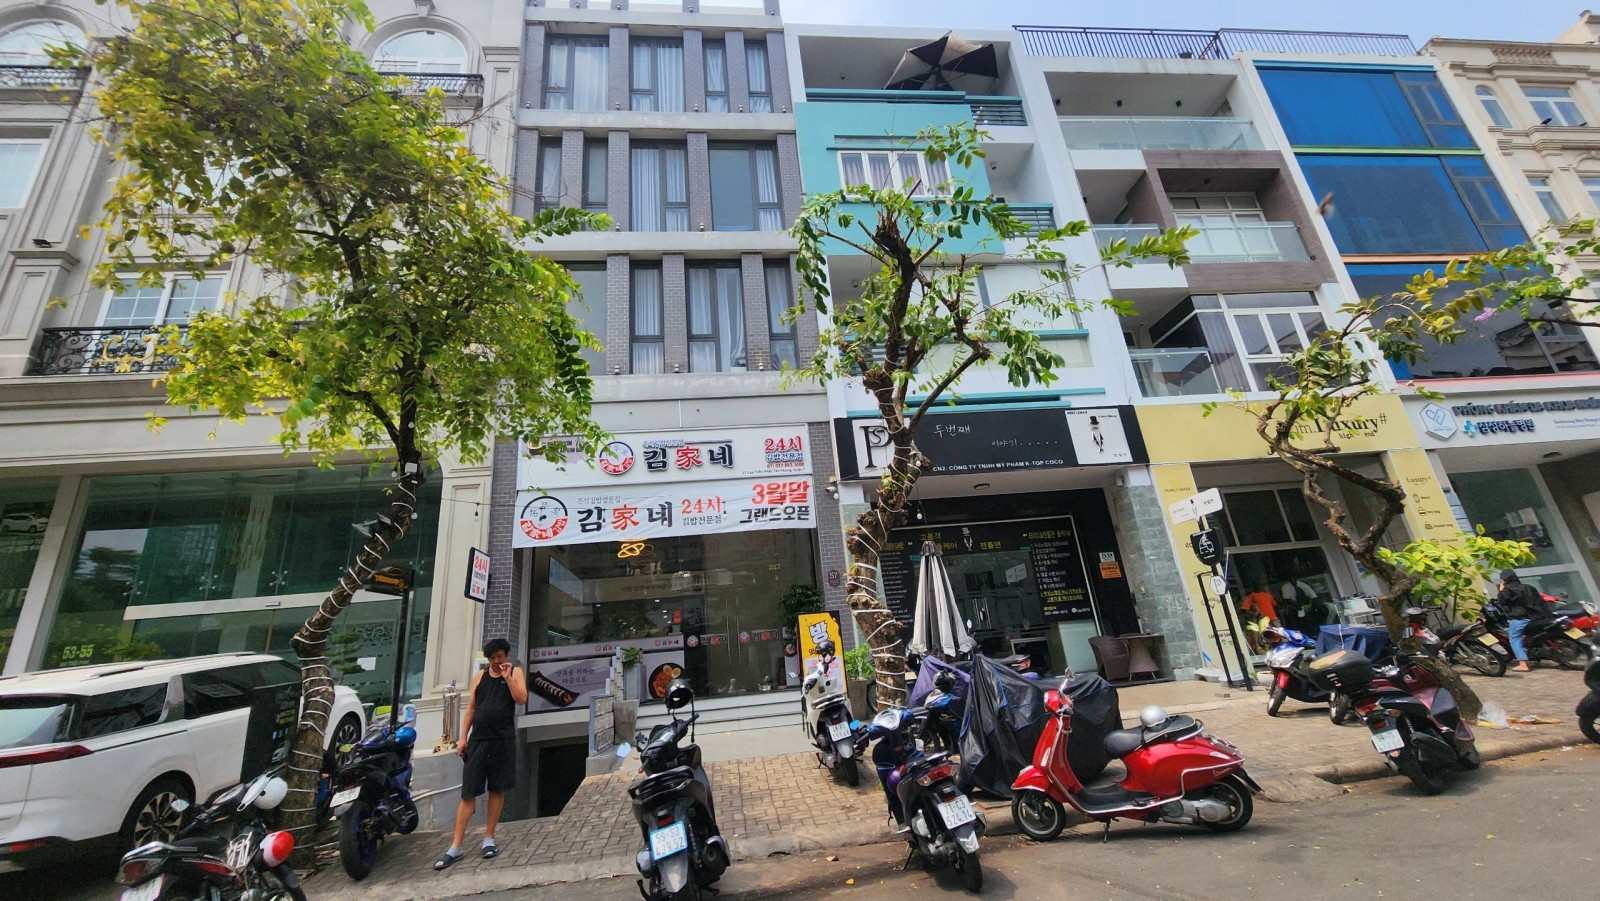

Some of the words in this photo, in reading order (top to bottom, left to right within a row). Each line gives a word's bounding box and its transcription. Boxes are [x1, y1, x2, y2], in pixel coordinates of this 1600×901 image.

[934, 424, 971, 438] 두번째
[764, 436, 803, 453] 24시
[642, 444, 734, 472] 김家네
[765, 452, 804, 462] 김밥전문점
[751, 481, 810, 505] 3월말
[680, 496, 721, 515] 24시
[740, 505, 810, 524] 그랜드오픈
[576, 501, 673, 533] 김家네
[682, 514, 722, 527] 김밥전문점
[62, 644, 95, 659] 53-55
